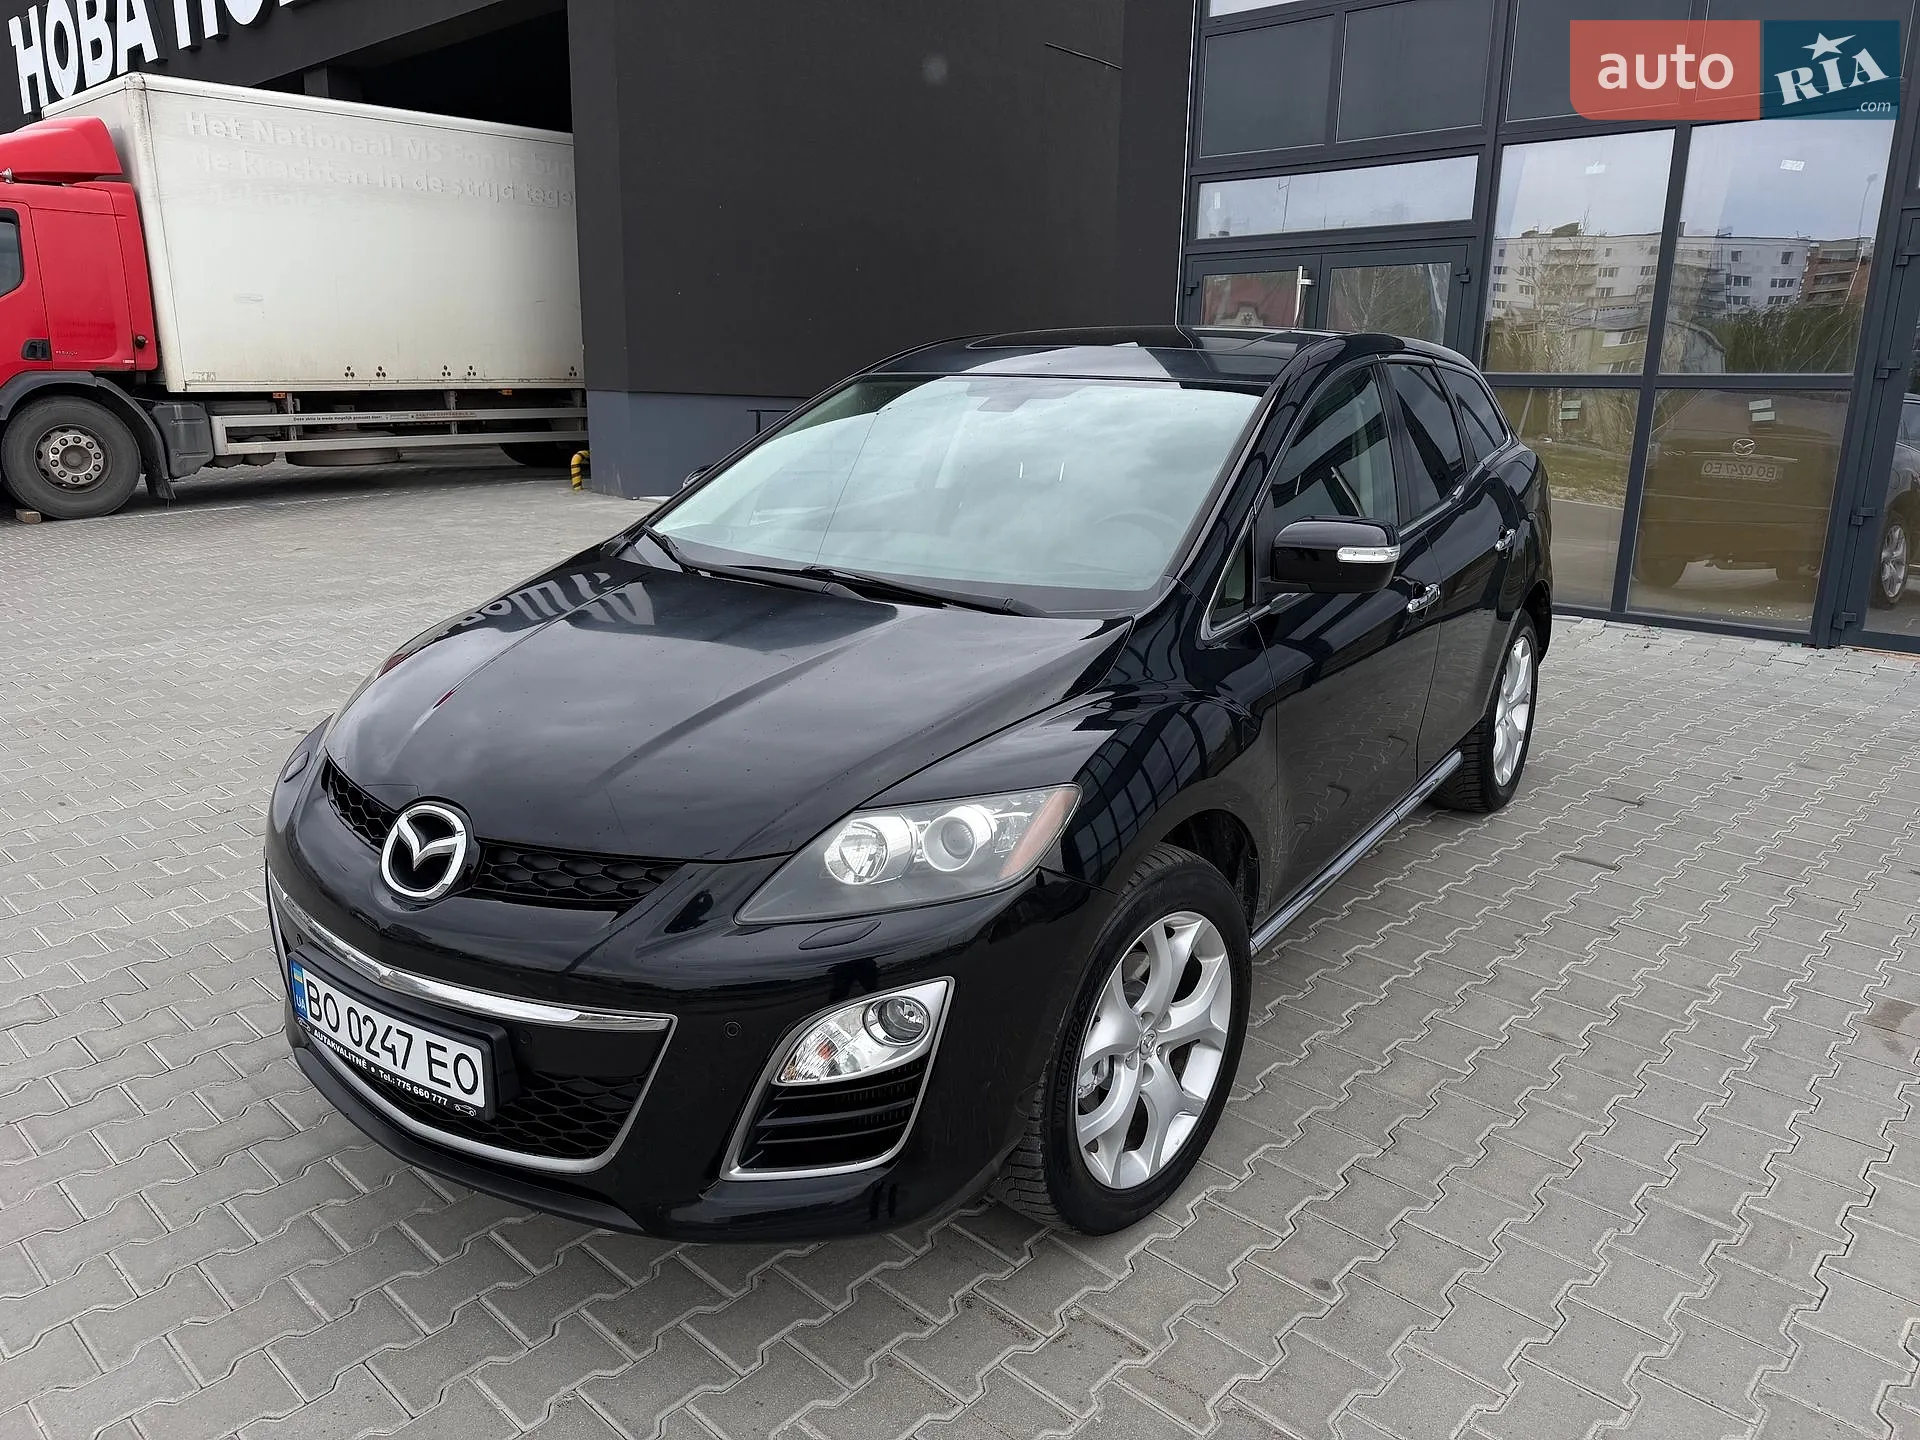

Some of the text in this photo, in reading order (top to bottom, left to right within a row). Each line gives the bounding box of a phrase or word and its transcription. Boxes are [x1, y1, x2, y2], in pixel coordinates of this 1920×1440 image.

[185, 111, 242, 140] Het
[252, 119, 392, 157] Nationaal
[412, 168, 445, 193] de
[295, 994, 307, 1012] UA
[306, 978, 479, 1096] BO 0247 EO
[379, 1070, 396, 1084] Tel.:
[396, 1078, 412, 1091] 775
[412, 1086, 430, 1099] 660
[431, 1093, 448, 1106] 777
